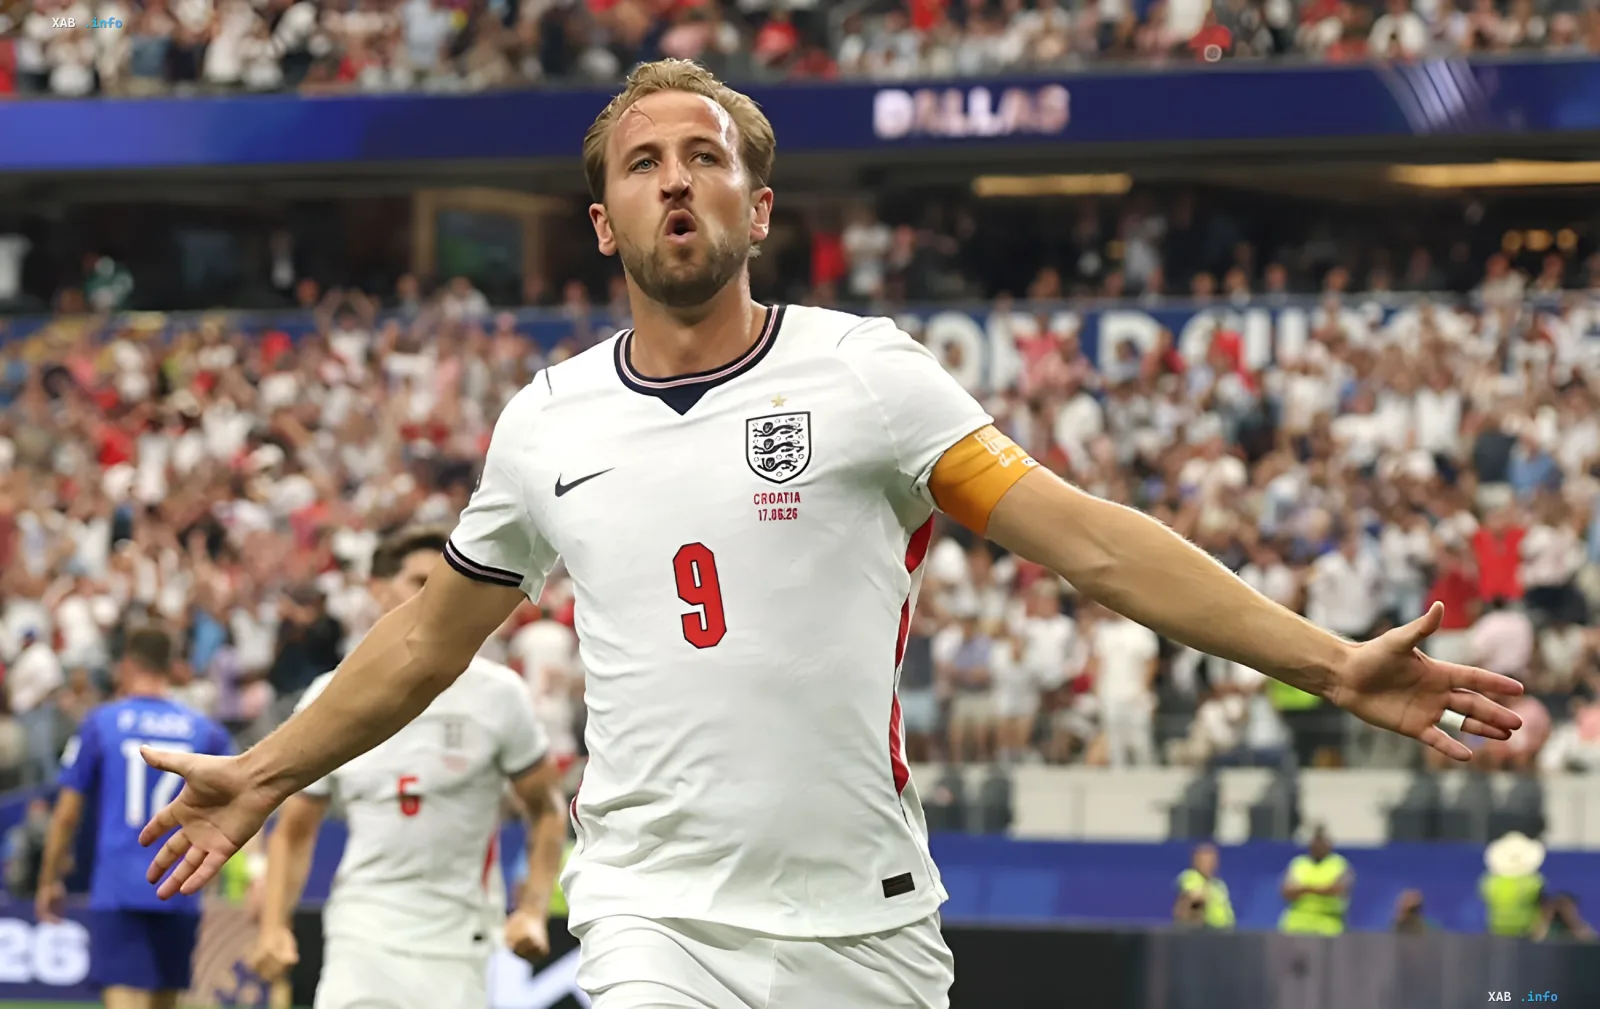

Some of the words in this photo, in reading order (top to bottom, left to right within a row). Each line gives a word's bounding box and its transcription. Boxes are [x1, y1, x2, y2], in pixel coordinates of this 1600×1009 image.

[873, 84, 1071, 139] DALLAS
[753, 491, 801, 505] CROATIA
[758, 507, 798, 521] 17.06.26
[672, 542, 727, 649] 9
[397, 775, 421, 817] 5
